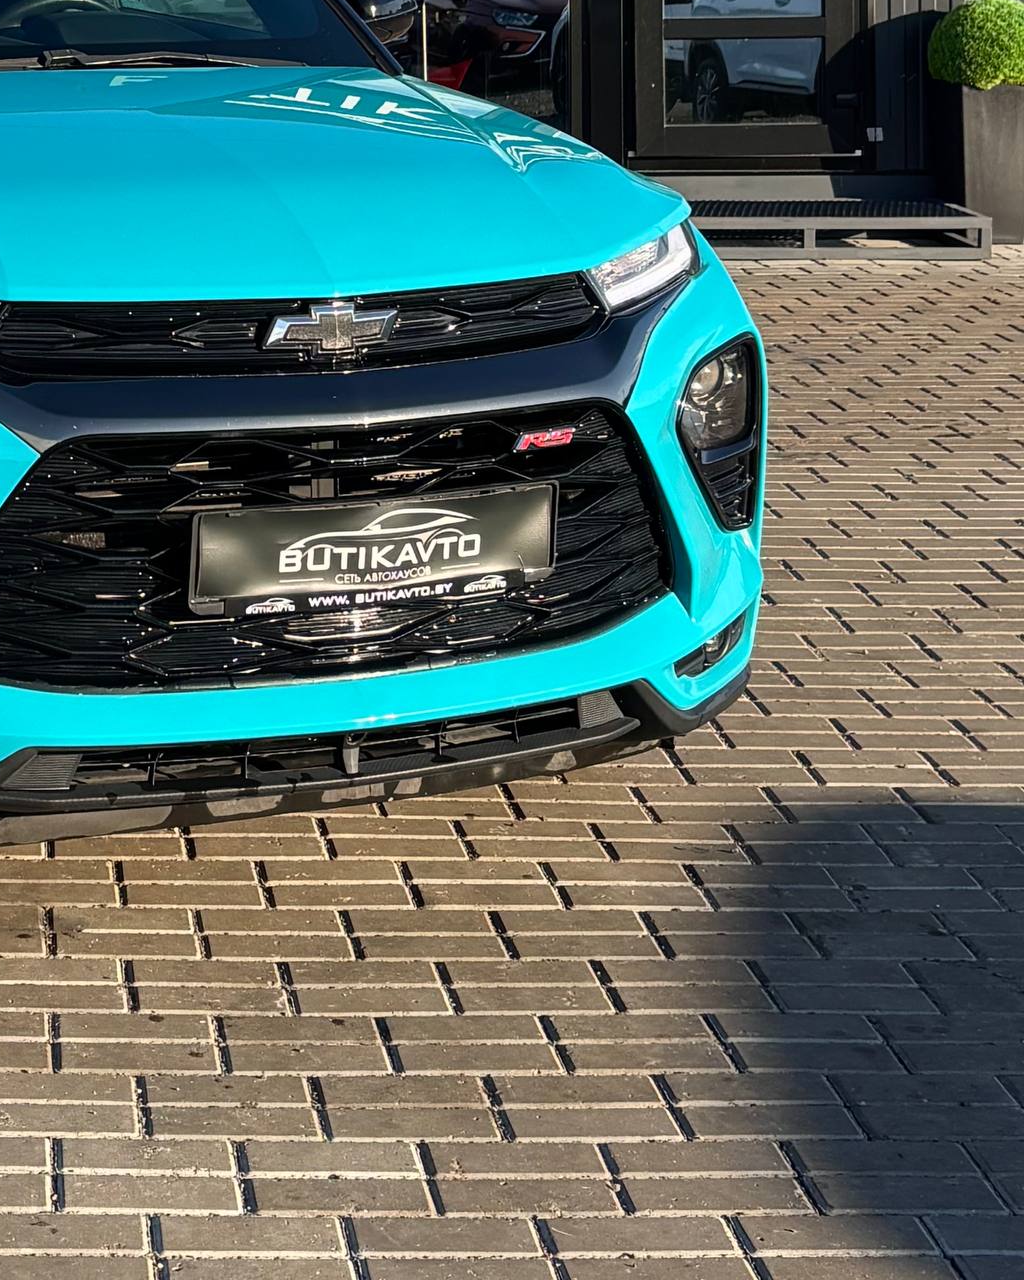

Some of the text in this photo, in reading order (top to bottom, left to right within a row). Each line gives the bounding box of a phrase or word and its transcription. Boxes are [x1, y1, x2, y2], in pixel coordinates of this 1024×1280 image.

[515, 427, 576, 451] RS
[278, 533, 482, 573] BUTIKAVTO
[334, 565, 432, 585] СЕТЬ АВТОХАУСОВ
[308, 582, 453, 608] WWW. BUTIKAVTO.BY
